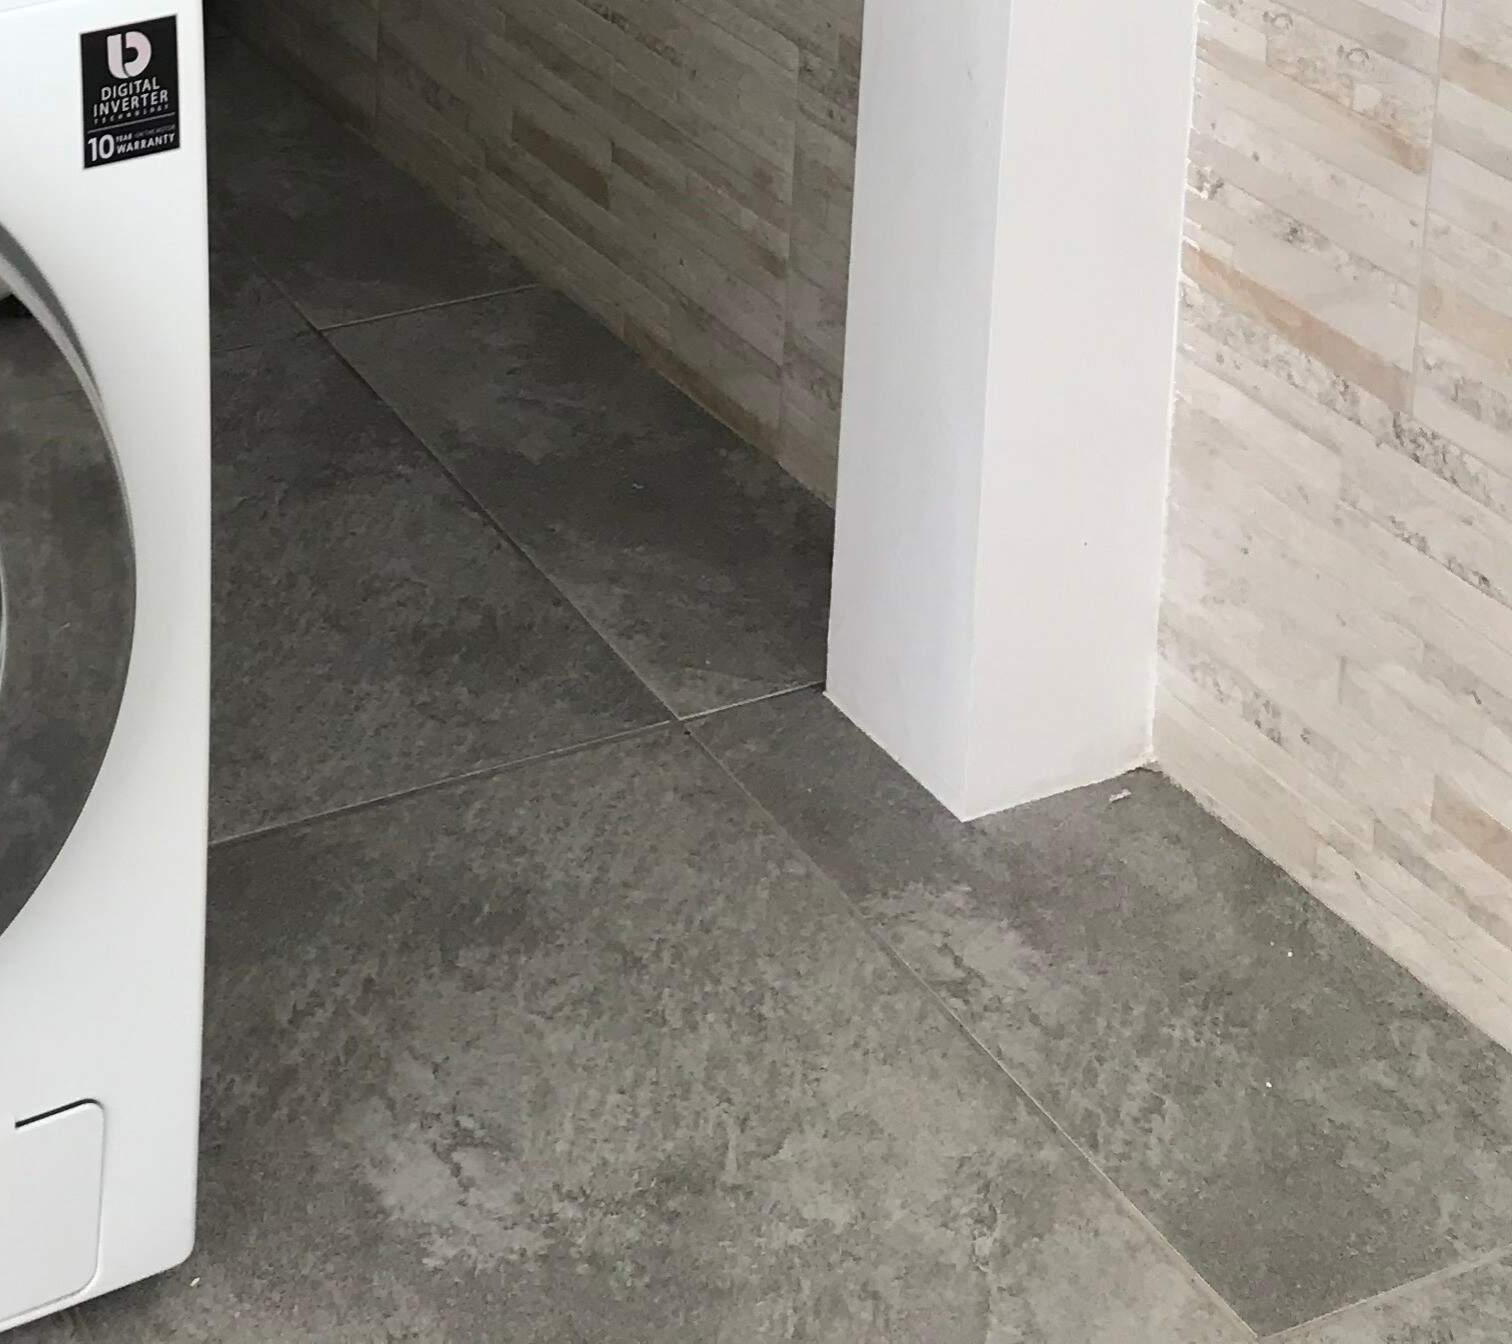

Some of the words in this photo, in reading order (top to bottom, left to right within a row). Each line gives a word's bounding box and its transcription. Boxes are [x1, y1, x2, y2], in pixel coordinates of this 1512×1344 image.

[101, 76, 161, 101] DIGITAL
[93, 89, 169, 118] INVERTER
[94, 103, 169, 125] TECHNOLOGY
[88, 133, 115, 162] 10
[116, 132, 176, 154] WARRANTY
